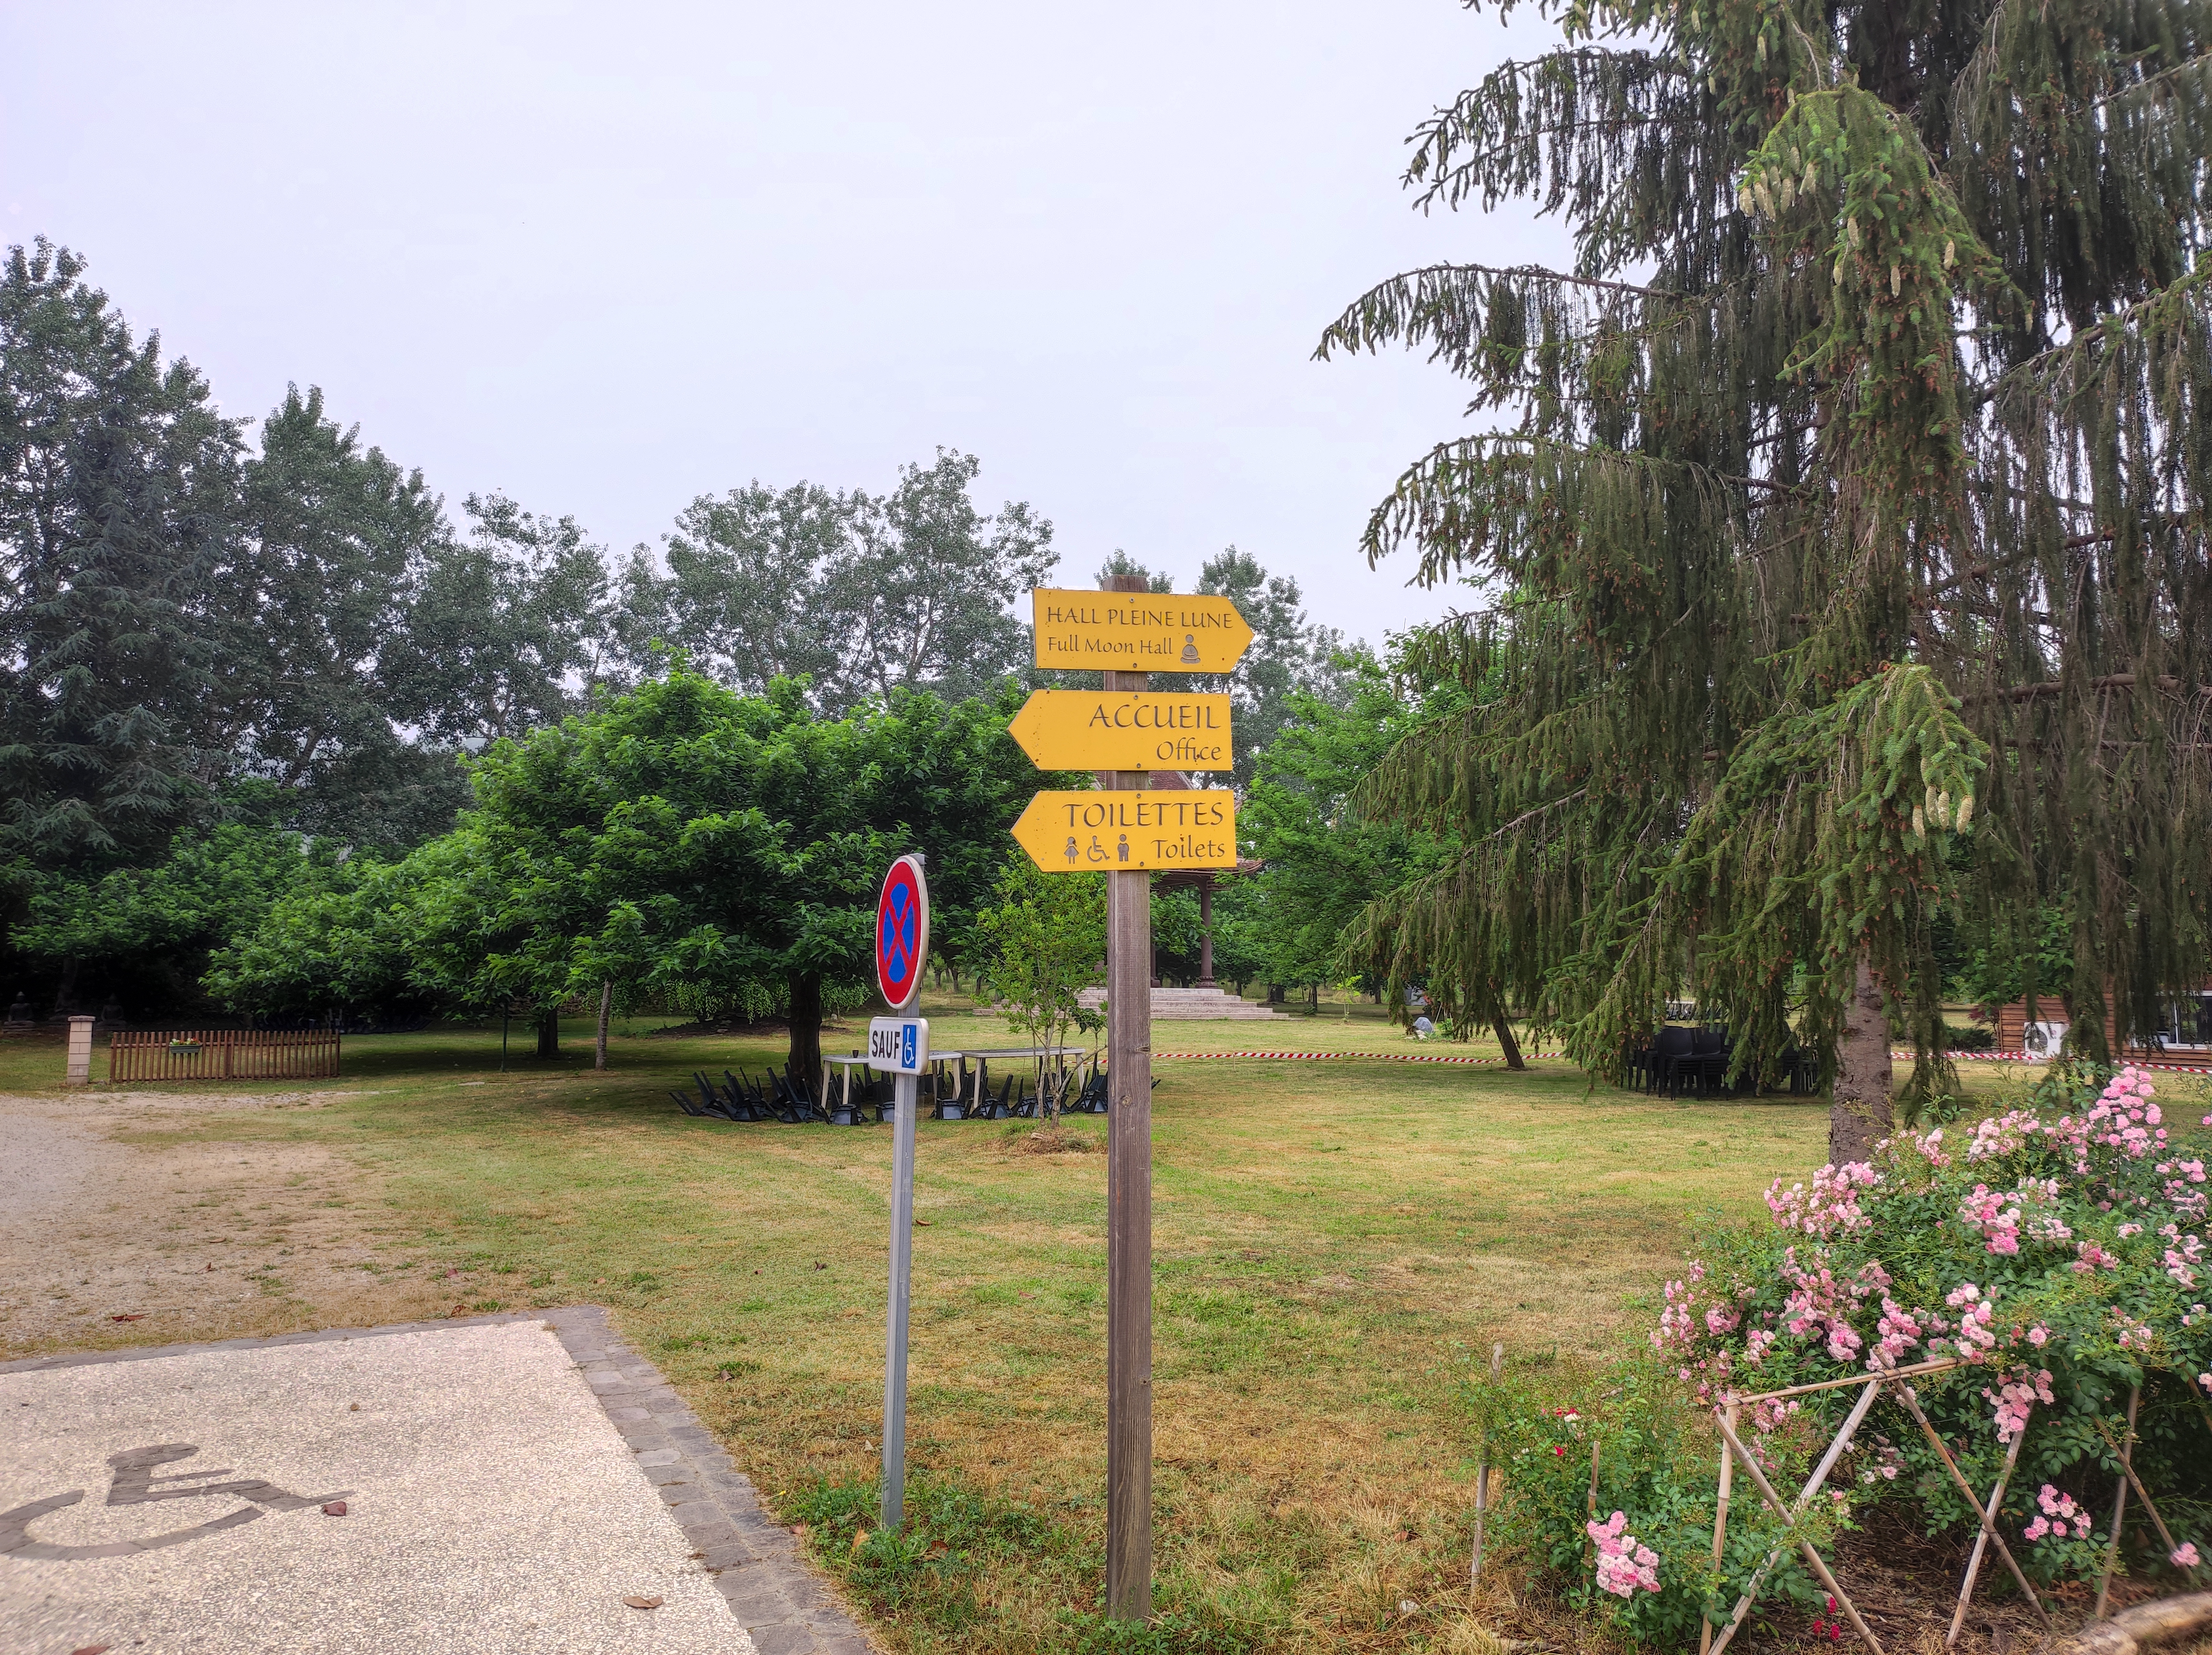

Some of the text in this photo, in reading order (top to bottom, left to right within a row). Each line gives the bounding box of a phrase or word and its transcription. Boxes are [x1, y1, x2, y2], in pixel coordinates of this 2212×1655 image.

[1047, 607, 1233, 629] HALL PLEINE LUNE
[1048, 634, 1173, 655] Full Moon Hall
[1089, 704, 1221, 729] ACCUEIL
[1157, 737, 1222, 761] Office
[1062, 802, 1224, 828] TOILETTES
[1151, 834, 1225, 859] Toilets
[872, 1031, 901, 1059] SAUF
